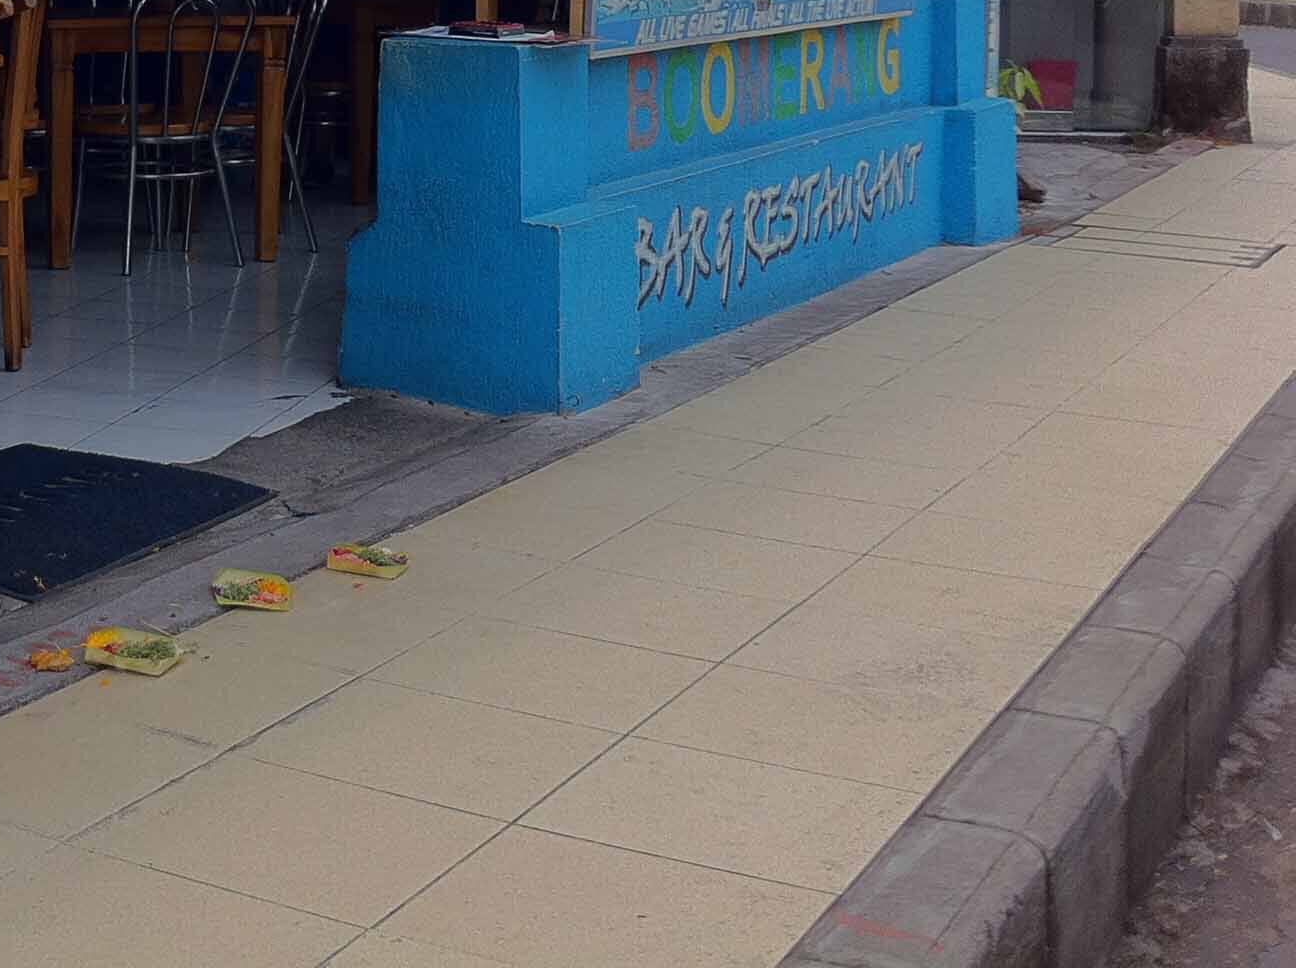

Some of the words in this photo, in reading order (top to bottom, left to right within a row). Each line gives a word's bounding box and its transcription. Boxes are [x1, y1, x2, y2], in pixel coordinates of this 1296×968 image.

[627, 17, 901, 152] BOOMERANG
[636, 18, 657, 46] ALL
[659, 15, 687, 42] LIVE
[688, 10, 729, 37] GAMES
[635, 205, 711, 312] BAR
[738, 142, 924, 290] RESTAURANT
